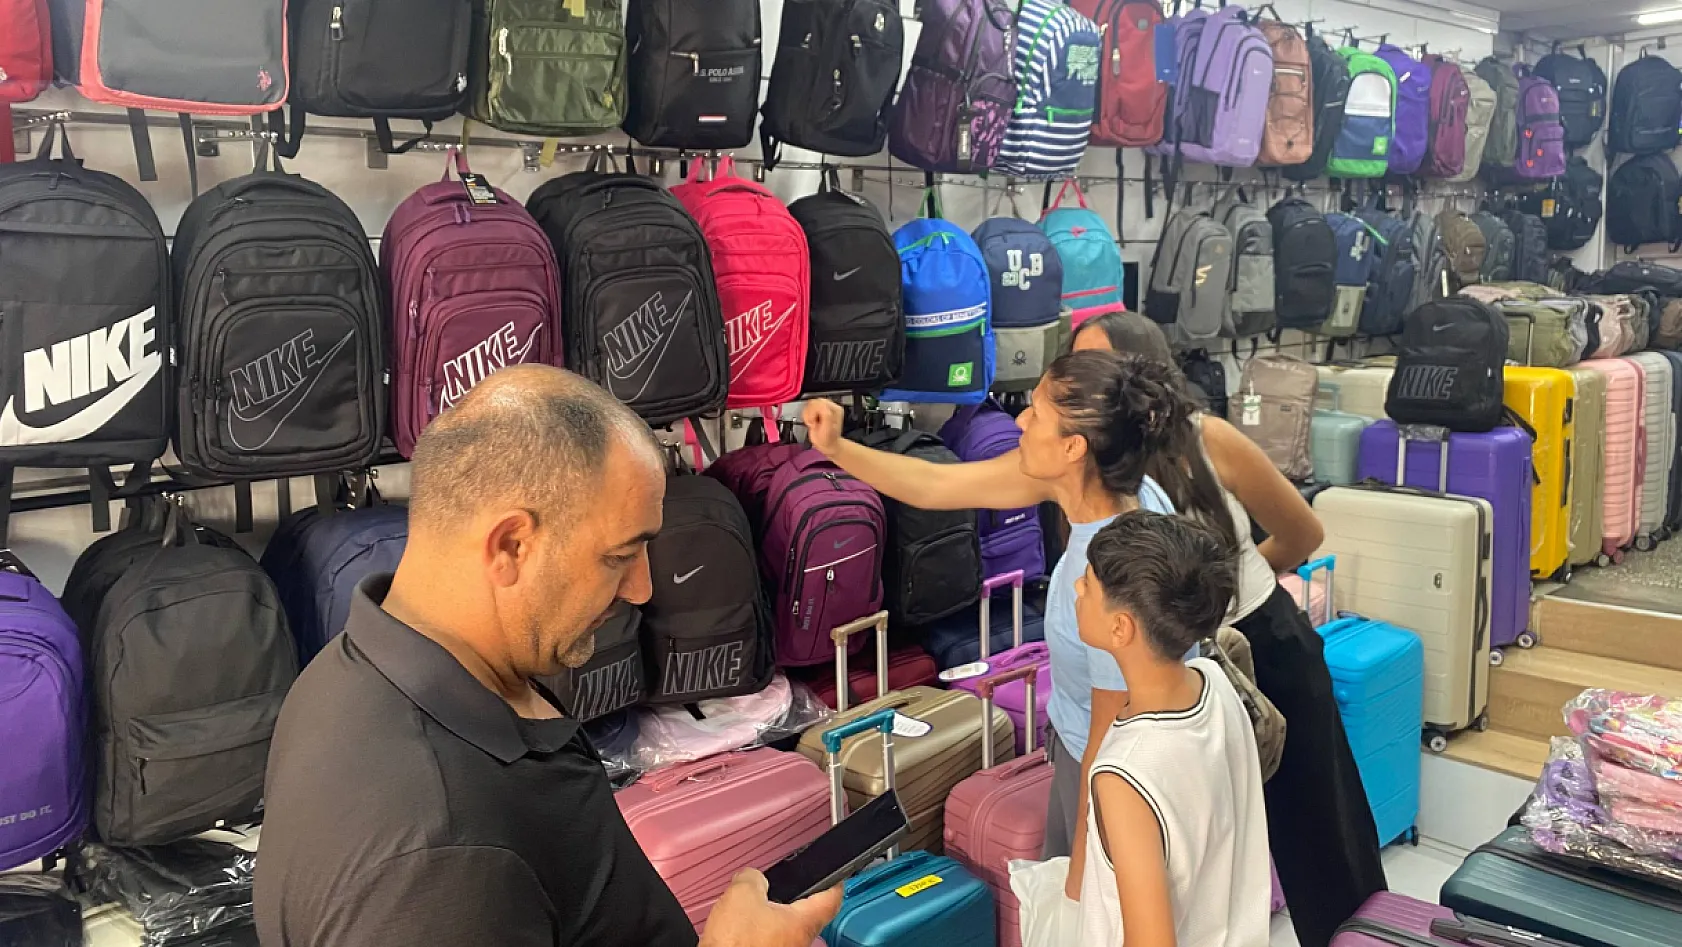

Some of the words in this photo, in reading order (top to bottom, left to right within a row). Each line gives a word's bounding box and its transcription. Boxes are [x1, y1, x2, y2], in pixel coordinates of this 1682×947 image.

[708, 68, 728, 77] POLO
[603, 291, 670, 371] NIKE
[24, 305, 157, 413] NIKE
[229, 328, 319, 411] NIKE
[443, 321, 519, 400] NIKE
[813, 339, 887, 382] NIKE
[1398, 366, 1459, 400] NIKE
[663, 640, 743, 695] NIKE
[20, 810, 36, 821] DO
